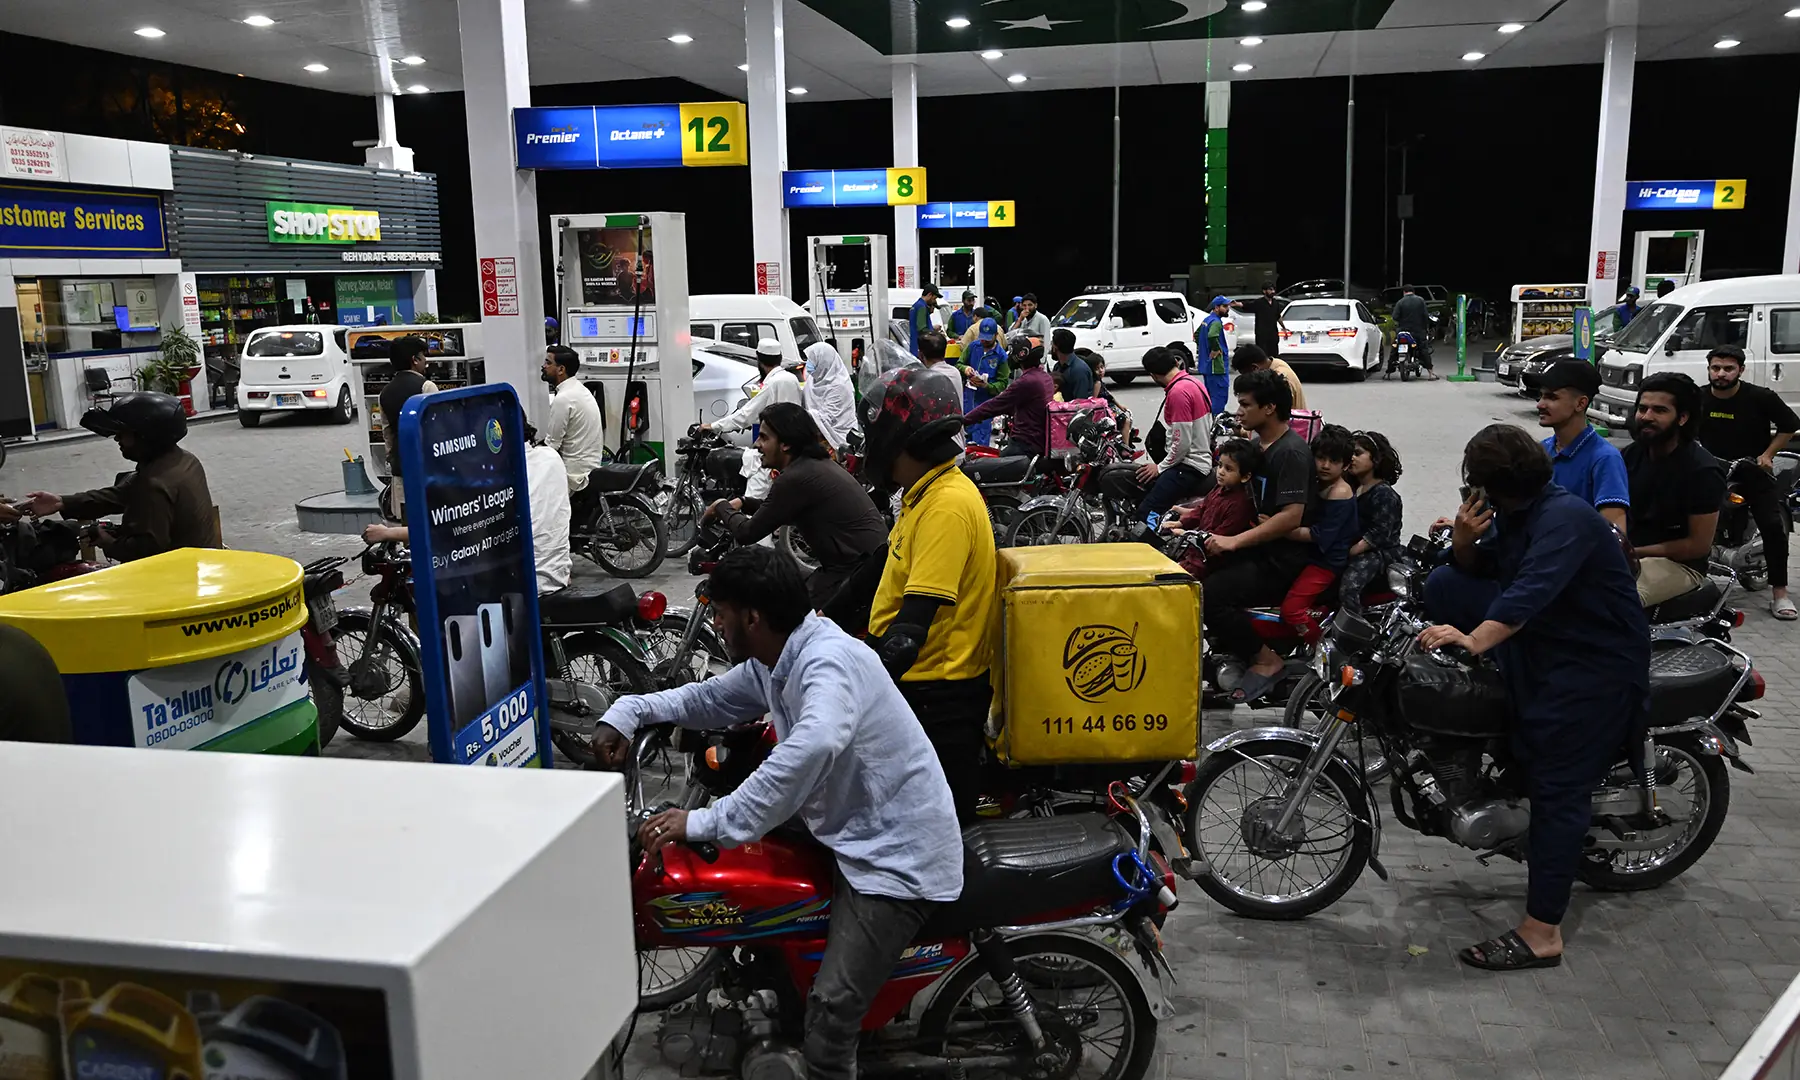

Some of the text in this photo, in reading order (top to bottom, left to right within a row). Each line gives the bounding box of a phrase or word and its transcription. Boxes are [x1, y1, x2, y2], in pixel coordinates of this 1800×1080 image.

[526, 132, 581, 145] Premier
[687, 116, 731, 153] 12
[897, 175, 914, 197] 8
[1721, 185, 1735, 203] 2
[0, 203, 145, 231] stomer Services
[994, 205, 1006, 221] 4
[432, 434, 477, 457] SAMSUNG
[431, 486, 514, 526] Winners' League
[452, 521, 472, 537] Where
[472, 515, 496, 529] everyone
[432, 553, 450, 569] Buy
[450, 542, 481, 561] Galaxy
[481, 537, 492, 551] A17
[492, 530, 505, 546] and
[505, 527, 515, 543] get
[251, 647, 298, 693] تعلق
[267, 674, 299, 693] CARE LINE
[142, 684, 214, 731] Ta'aluq
[146, 709, 214, 747] 0800-03000
[465, 741, 482, 757] Rs.
[481, 690, 528, 743] 5,000
[1041, 713, 1168, 735] 111 44 66 99
[498, 736, 523, 760] Voucher
[684, 916, 744, 925] NEW ASIA
